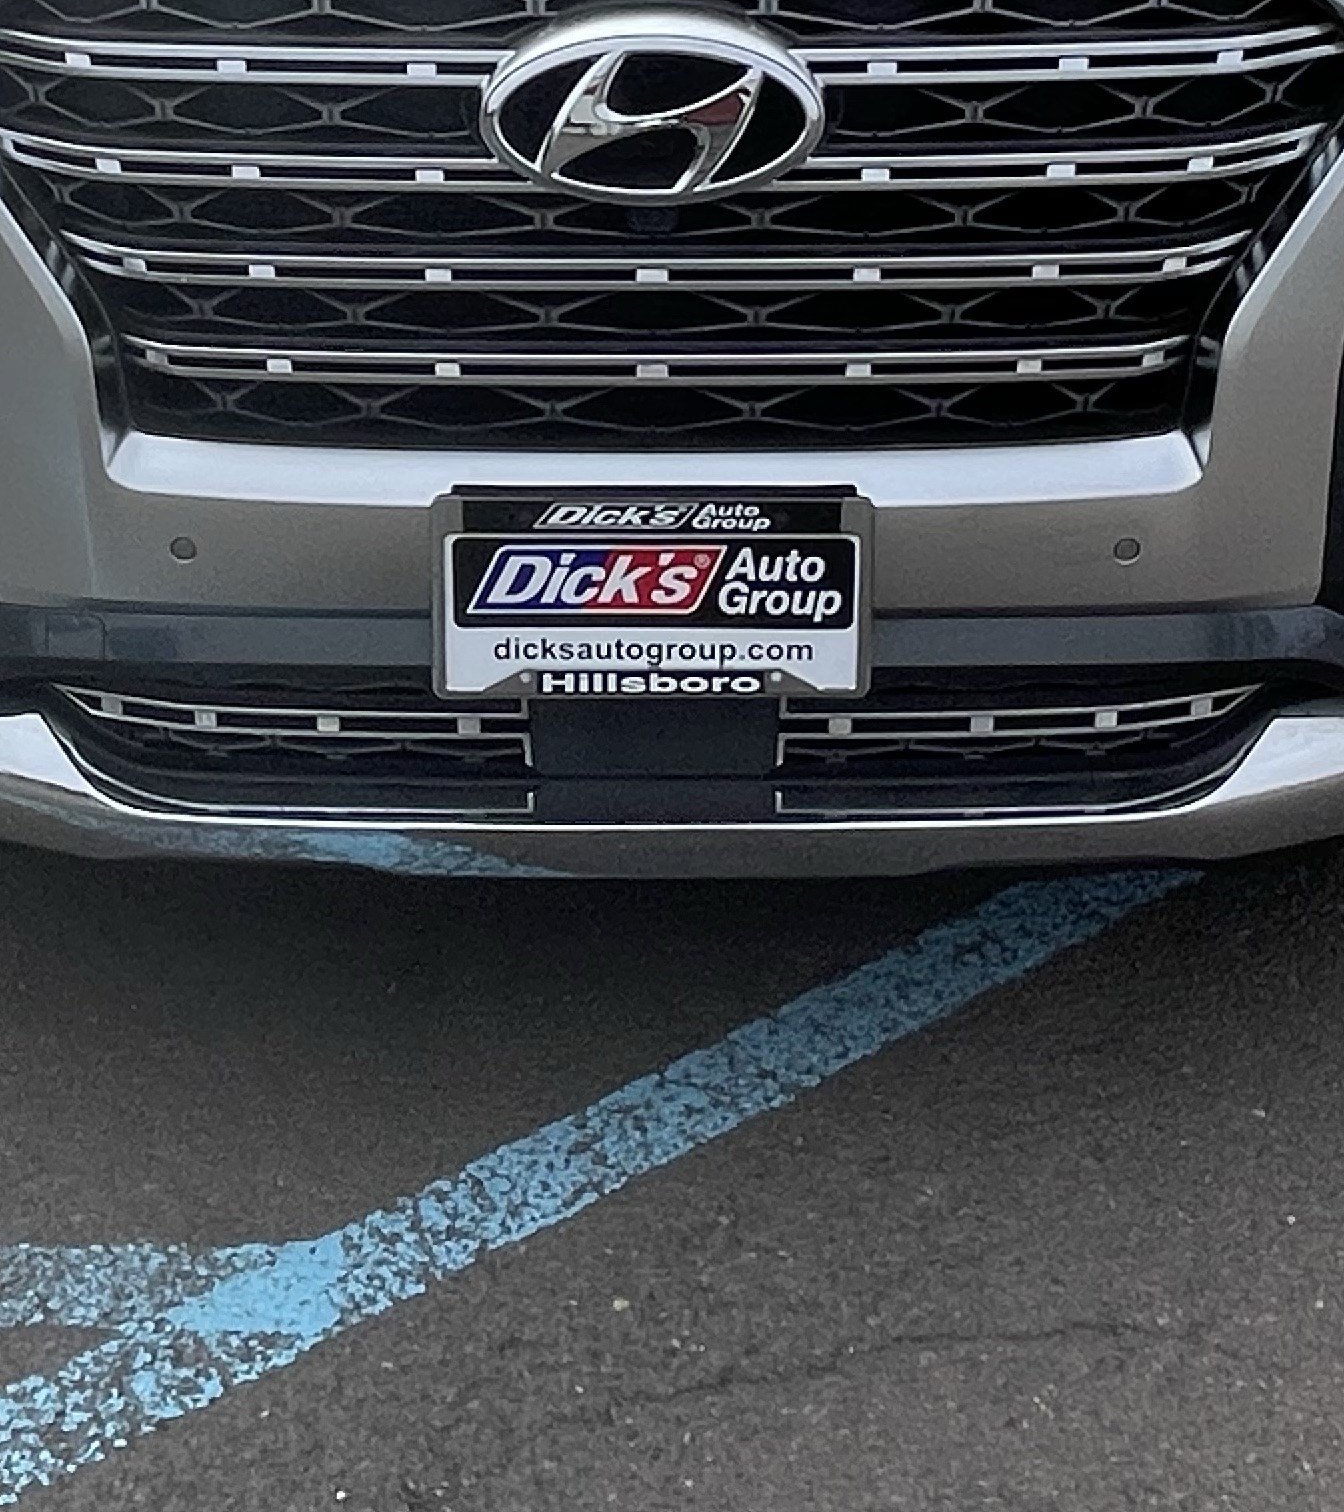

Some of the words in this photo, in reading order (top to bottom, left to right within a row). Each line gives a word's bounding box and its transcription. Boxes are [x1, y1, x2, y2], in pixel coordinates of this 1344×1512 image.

[545, 503, 680, 526] Dick's
[699, 502, 760, 517] Auto
[691, 516, 772, 532] Group
[724, 546, 826, 583] Auto
[486, 552, 699, 605] Dick's
[717, 582, 843, 623] Group
[493, 637, 814, 668] dicksautogroup.com
[541, 671, 761, 694] Hillsboro
